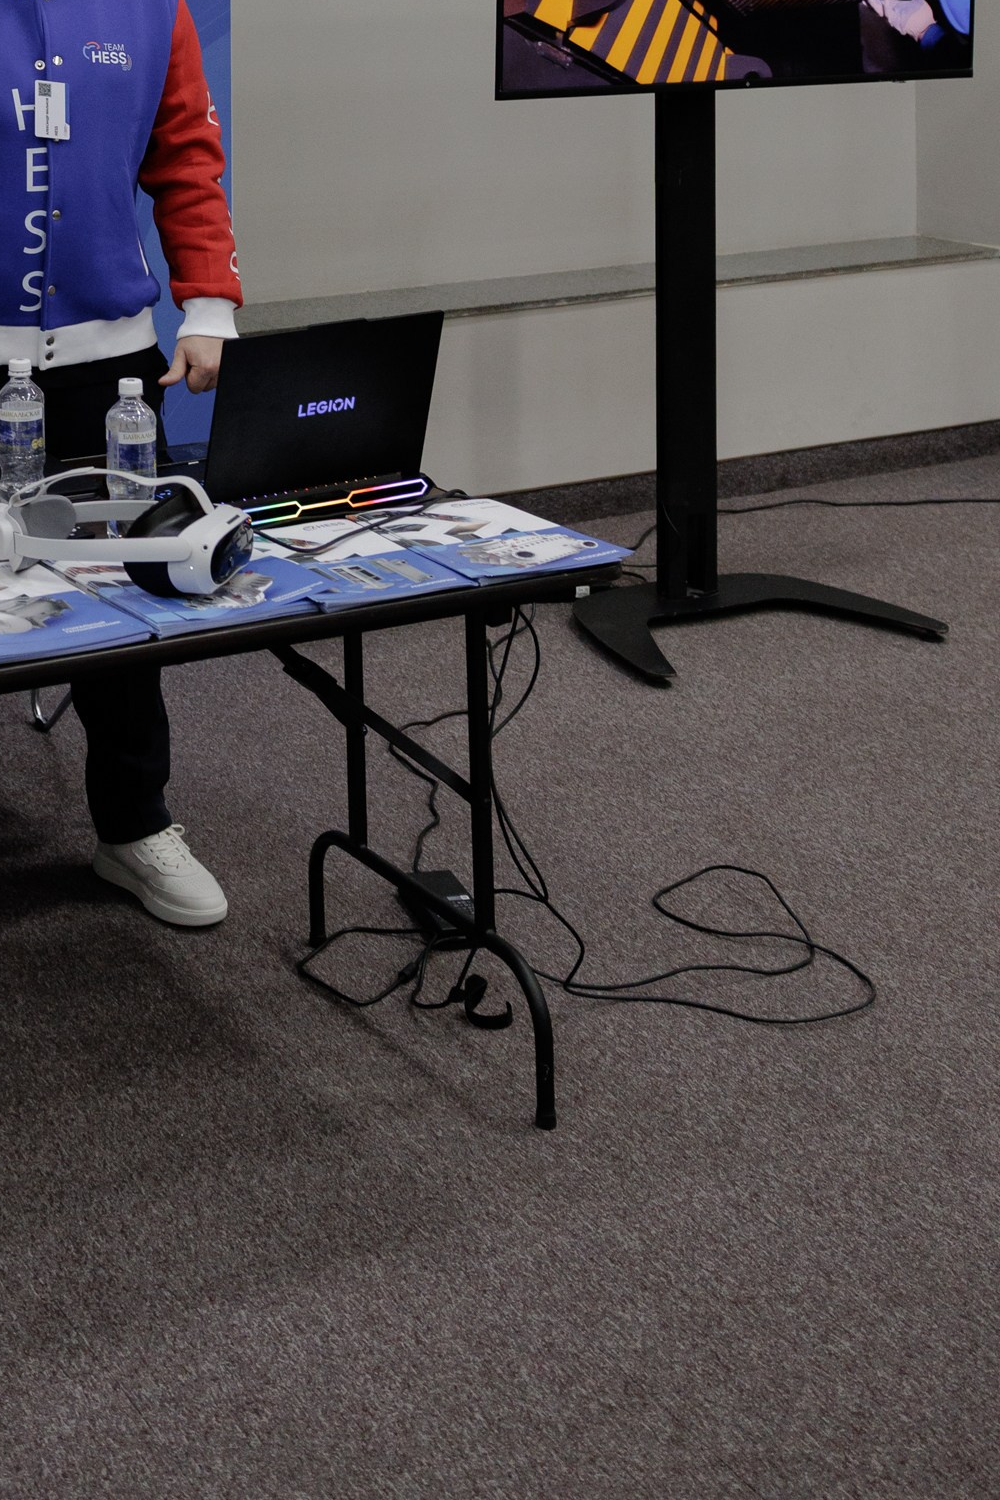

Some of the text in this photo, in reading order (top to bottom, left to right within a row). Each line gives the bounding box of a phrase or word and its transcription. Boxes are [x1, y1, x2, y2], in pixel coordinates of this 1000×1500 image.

[103, 42, 125, 51] TEAM
[91, 50, 127, 65] HESS
[297, 396, 356, 418] LEGION
